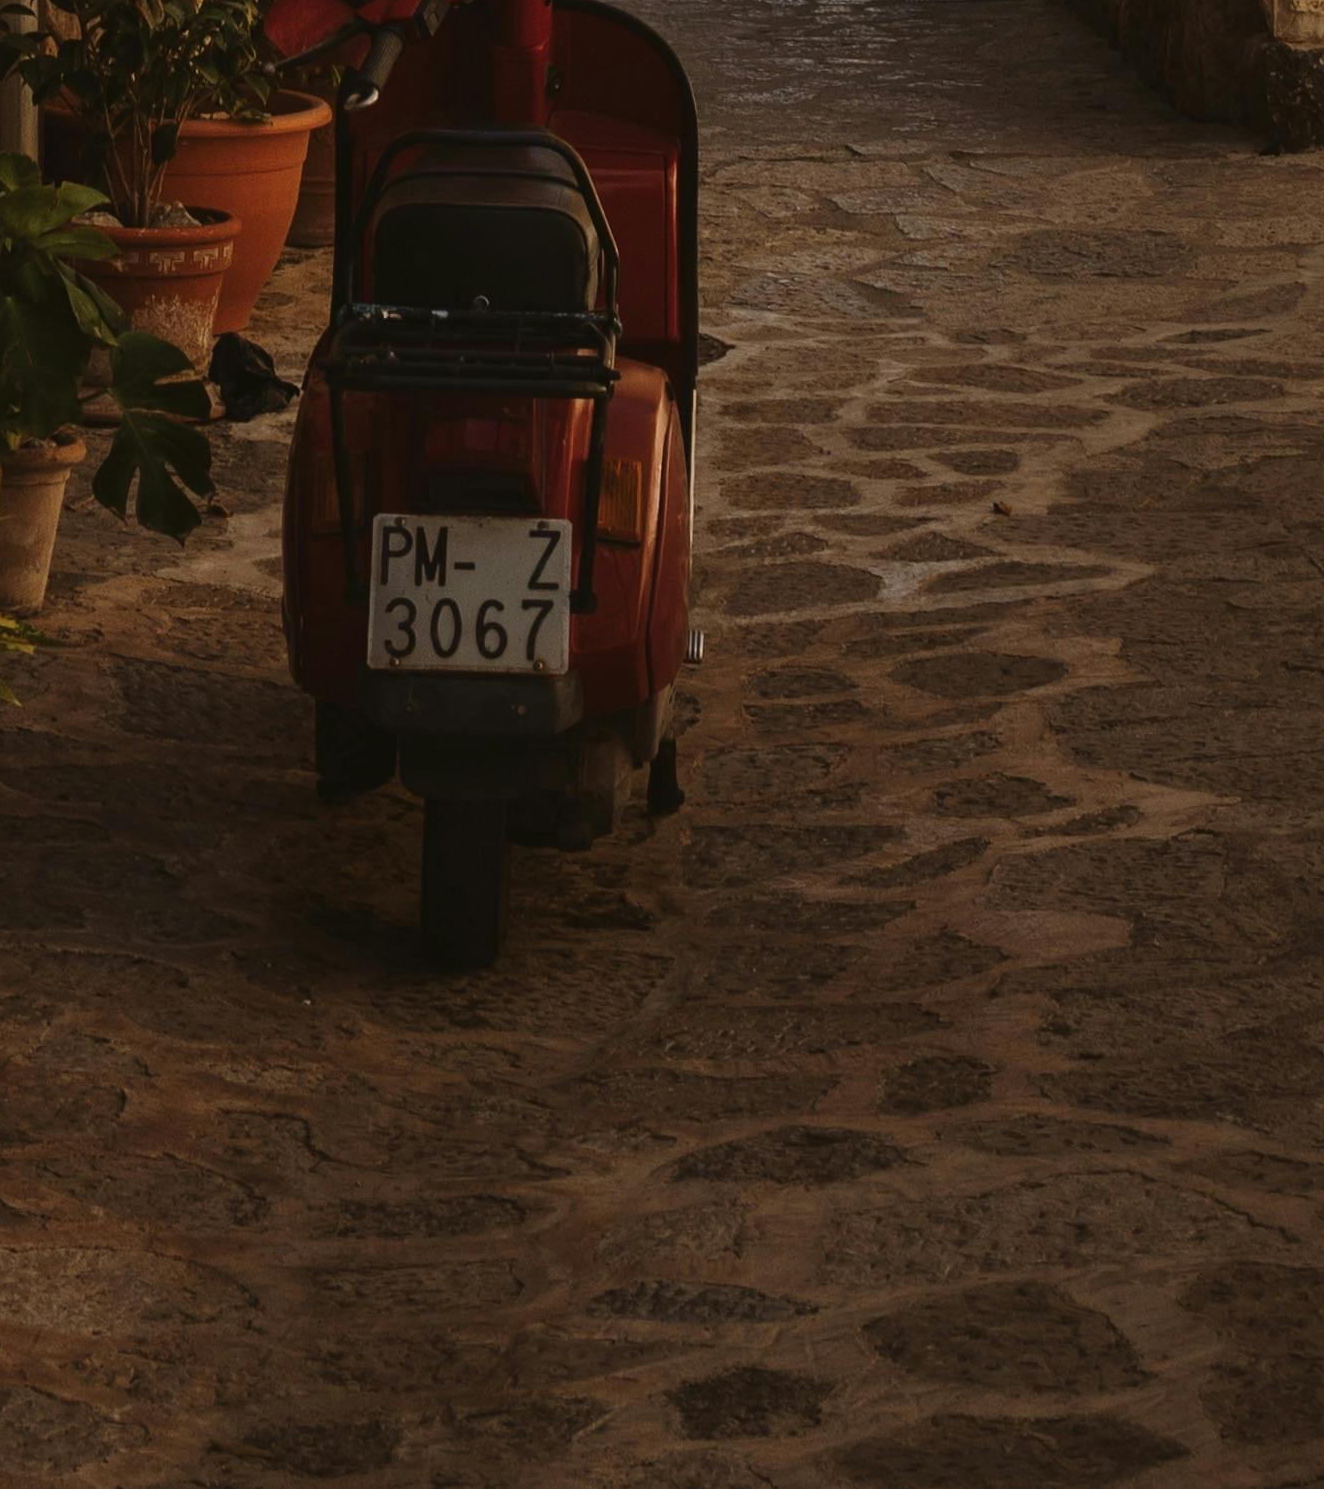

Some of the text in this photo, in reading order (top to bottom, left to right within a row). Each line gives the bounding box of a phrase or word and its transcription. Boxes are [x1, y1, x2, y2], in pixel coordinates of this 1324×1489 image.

[380, 526, 561, 590] PM- Z
[384, 597, 554, 661] 3067
